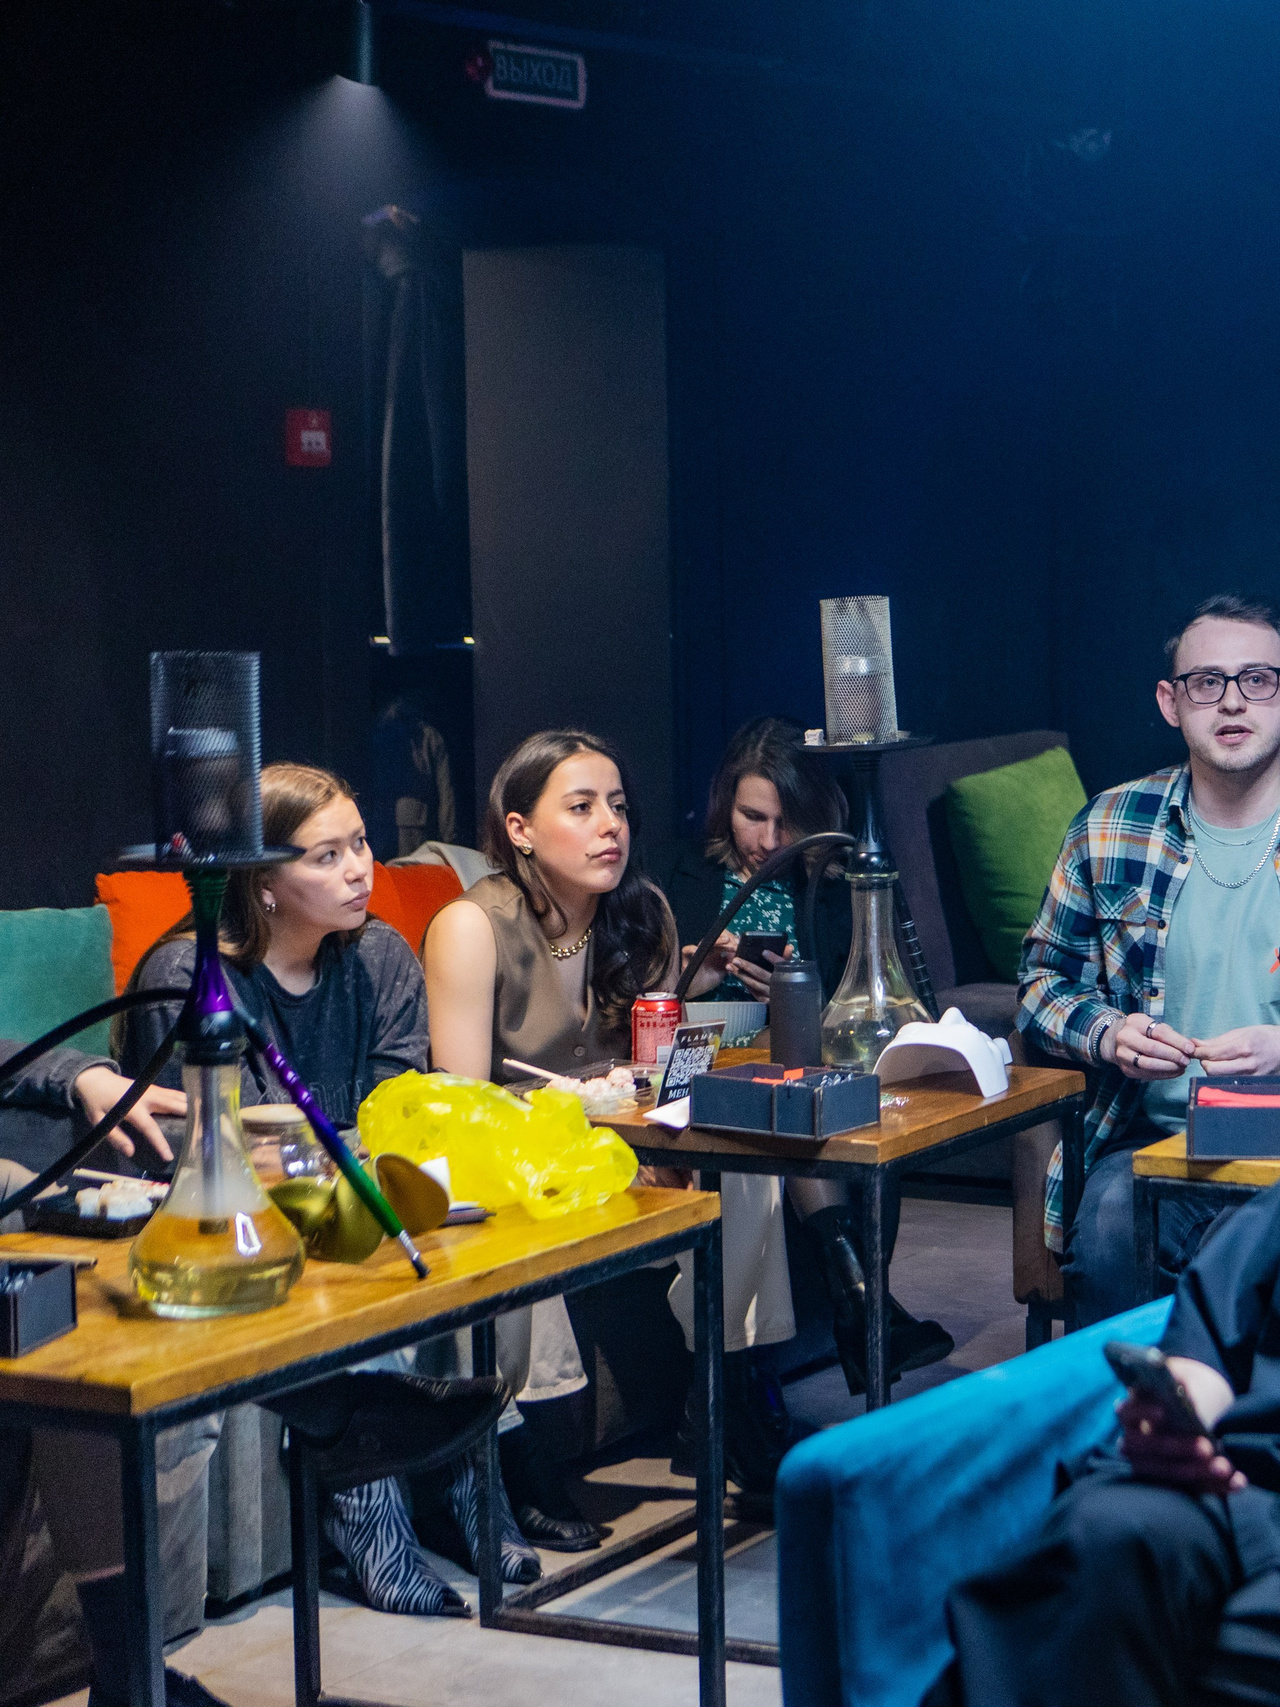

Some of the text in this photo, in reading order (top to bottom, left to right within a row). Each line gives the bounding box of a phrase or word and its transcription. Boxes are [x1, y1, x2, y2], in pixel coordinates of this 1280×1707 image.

[495, 54, 573, 92] ВЫХОД
[681, 1032, 714, 1043] FLAME
[667, 1087, 690, 1100] МЕН
